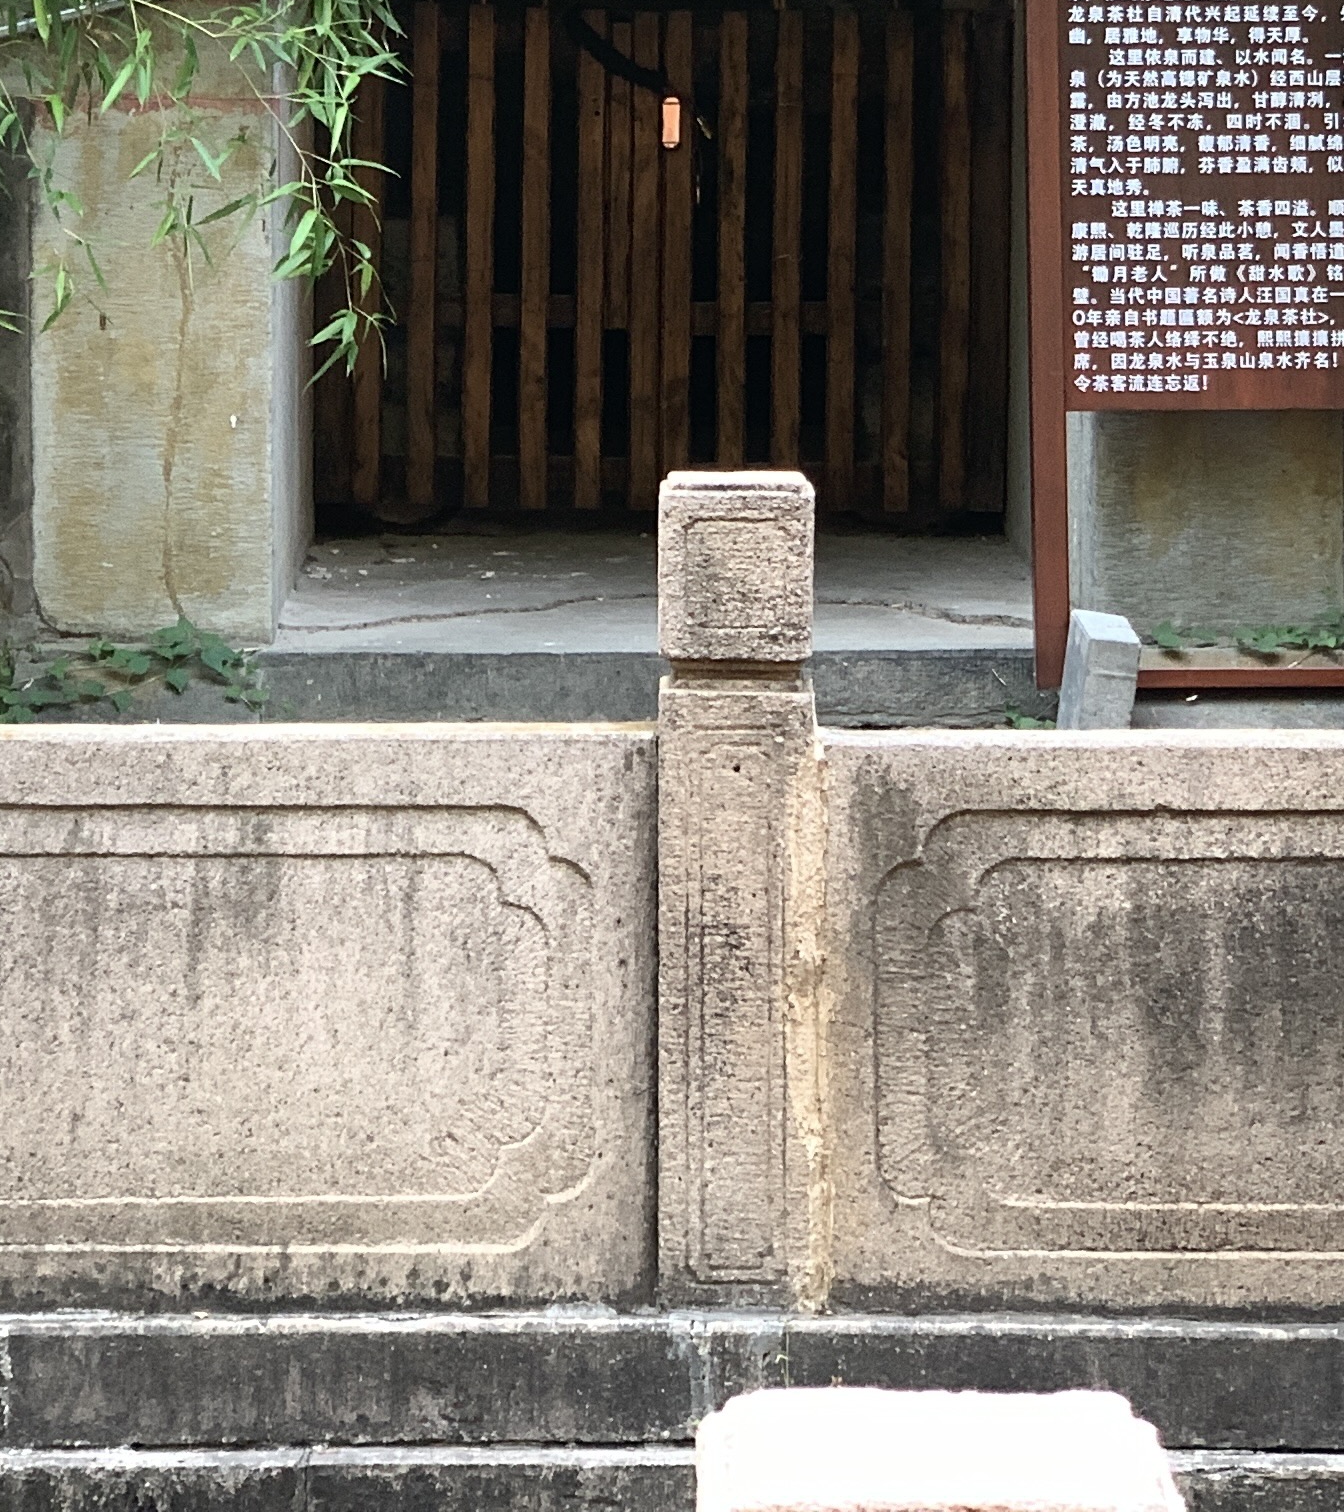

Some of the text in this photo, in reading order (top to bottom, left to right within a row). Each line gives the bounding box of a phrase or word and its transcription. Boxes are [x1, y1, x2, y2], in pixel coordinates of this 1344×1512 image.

[1071, 178, 1150, 196] 天真地秀。
[1074, 374, 1208, 393] 令茶客流连忘返！
